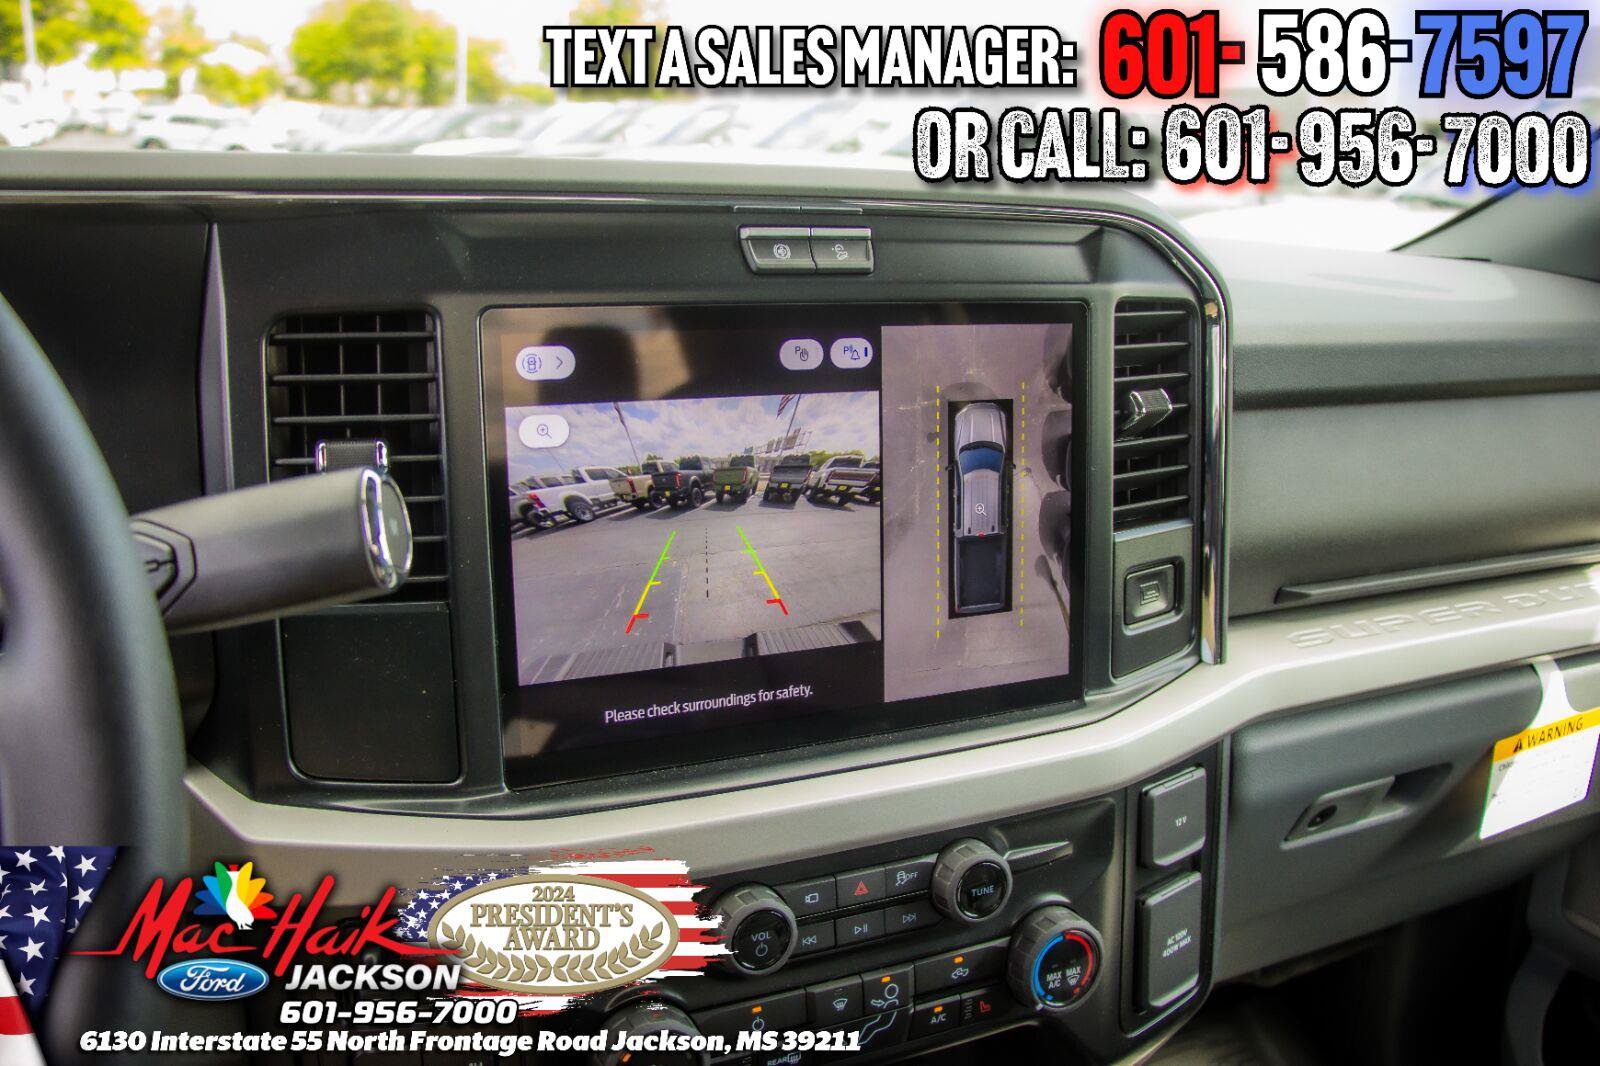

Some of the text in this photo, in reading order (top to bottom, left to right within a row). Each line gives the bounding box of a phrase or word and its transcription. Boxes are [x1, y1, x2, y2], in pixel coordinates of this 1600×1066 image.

[1287, 600, 1502, 649] SUPER
[604, 683, 814, 724] Please check surroundings for safety.
[1527, 717, 1584, 748] WARNING
[906, 871, 919, 880] OFF
[971, 884, 995, 897] TUNE
[751, 931, 771, 943] VOL
[1046, 971, 1062, 982] MAX
[1065, 966, 1081, 977] MAX
[930, 1013, 948, 1025] A/C
